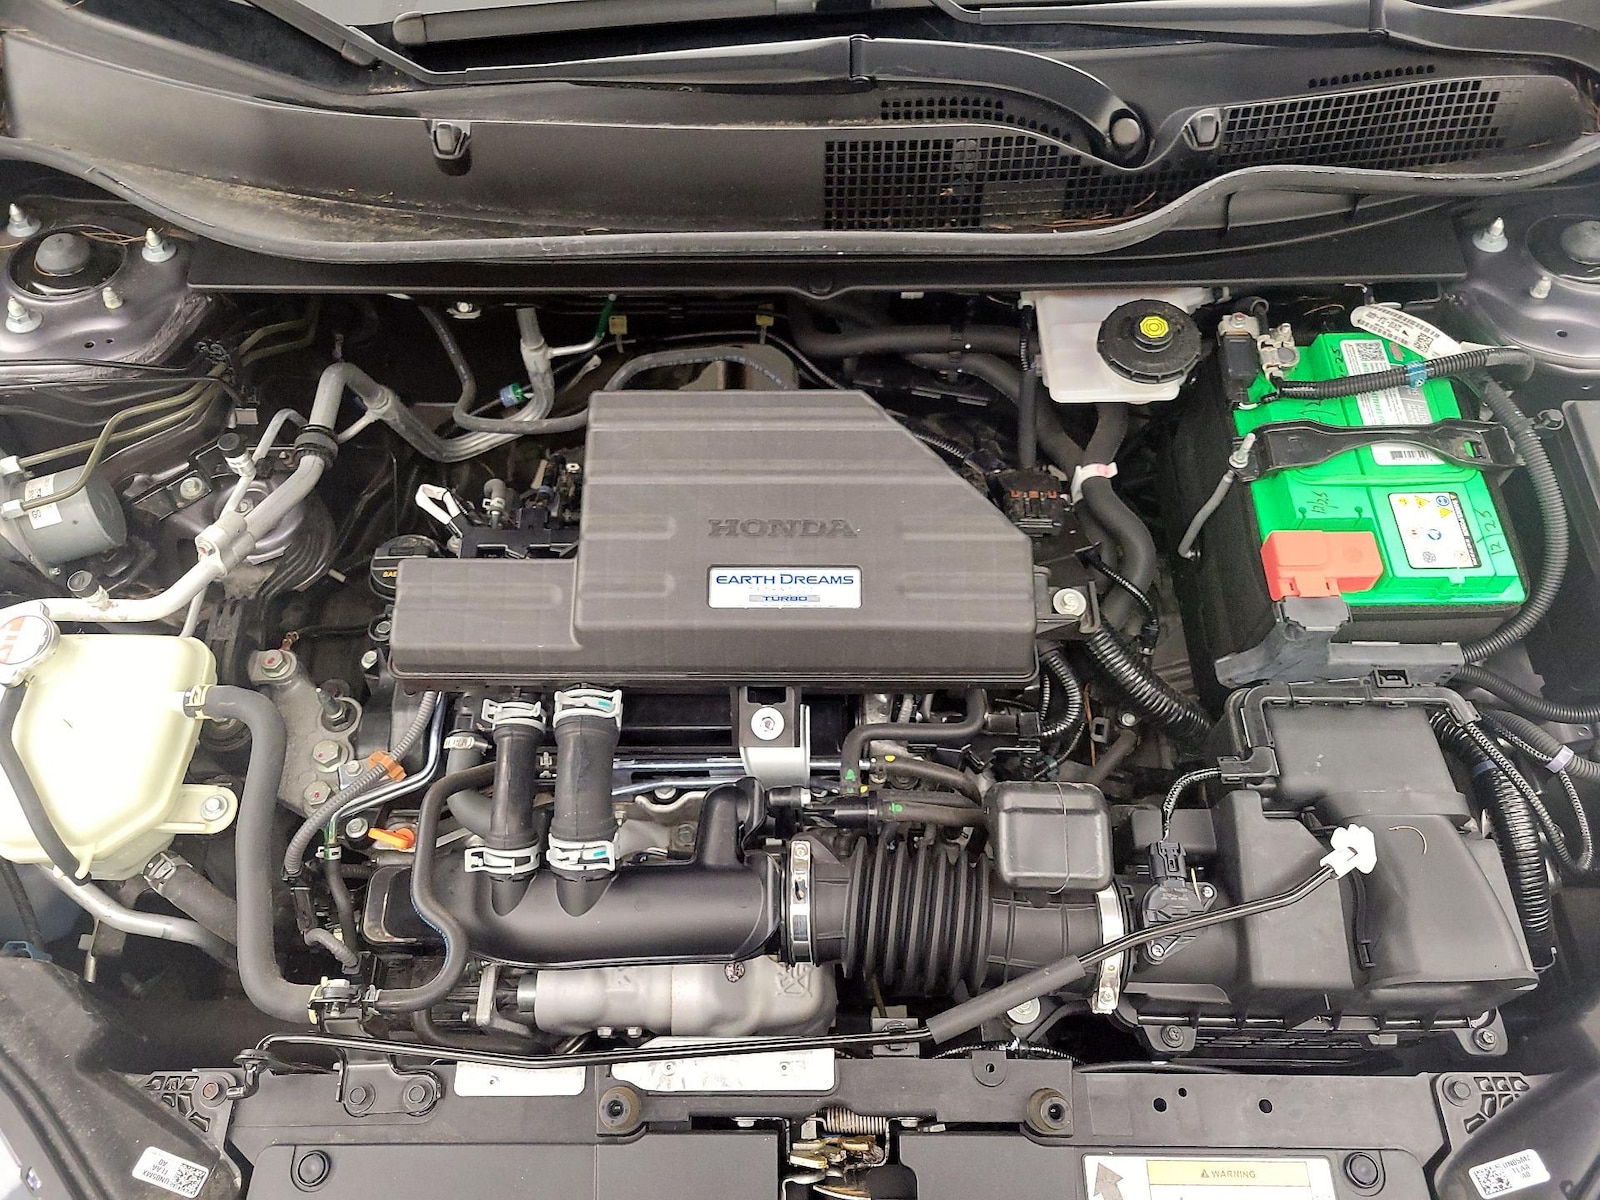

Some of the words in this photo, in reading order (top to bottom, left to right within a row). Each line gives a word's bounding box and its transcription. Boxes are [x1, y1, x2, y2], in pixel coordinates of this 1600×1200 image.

[707, 519, 858, 538] HONDA
[716, 575, 775, 585] EARTH
[780, 573, 854, 585] DREAMS
[1211, 1170, 1256, 1179] WARNING
